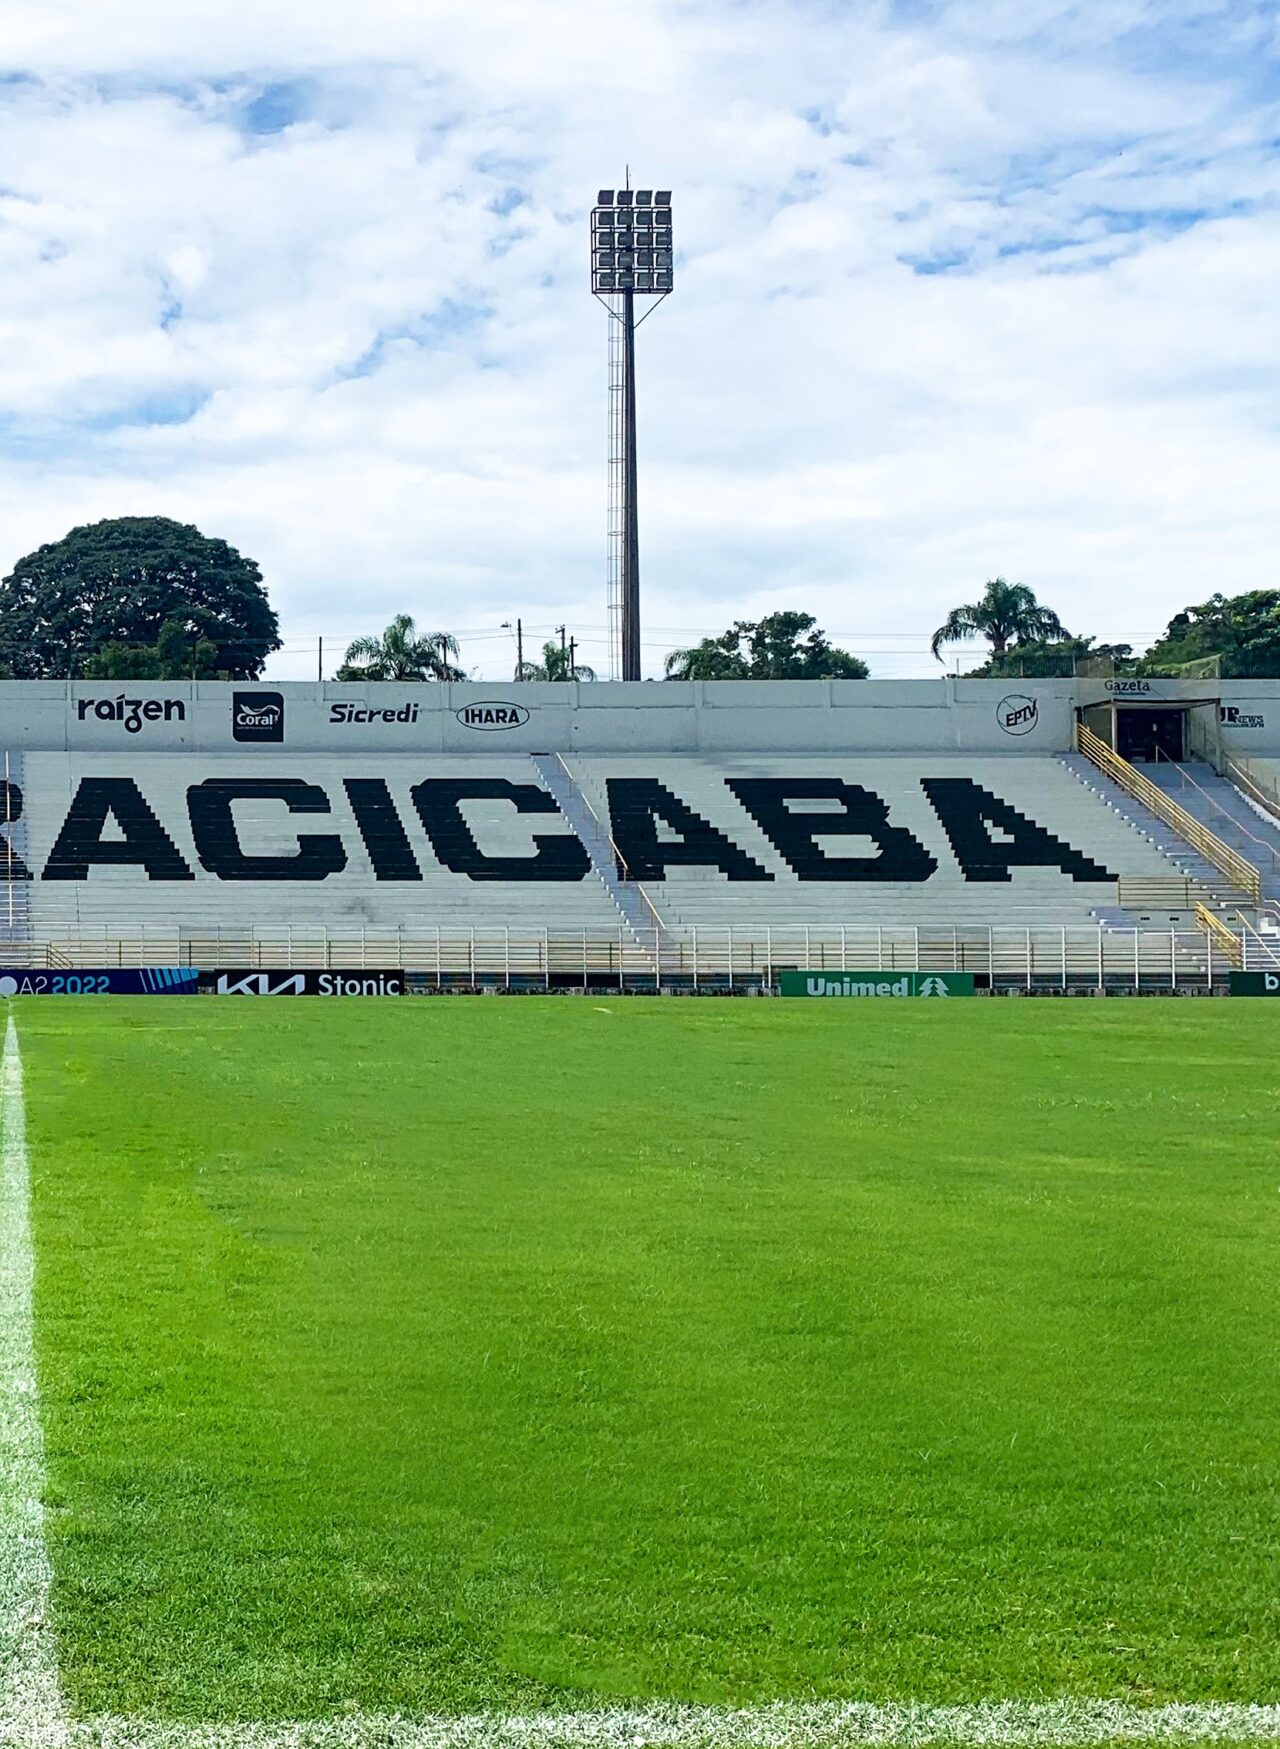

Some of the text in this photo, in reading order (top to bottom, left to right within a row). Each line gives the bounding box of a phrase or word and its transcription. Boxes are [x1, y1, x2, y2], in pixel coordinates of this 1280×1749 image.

[78, 693, 185, 733] raízen
[237, 713, 273, 725] Coral
[330, 703, 419, 723] Sicredi
[465, 709, 520, 723] IHARA
[1006, 699, 1037, 727] EPTV
[52, 976, 110, 995] 2022
[318, 974, 400, 996] Stonic
[806, 977, 908, 996] Unimed
